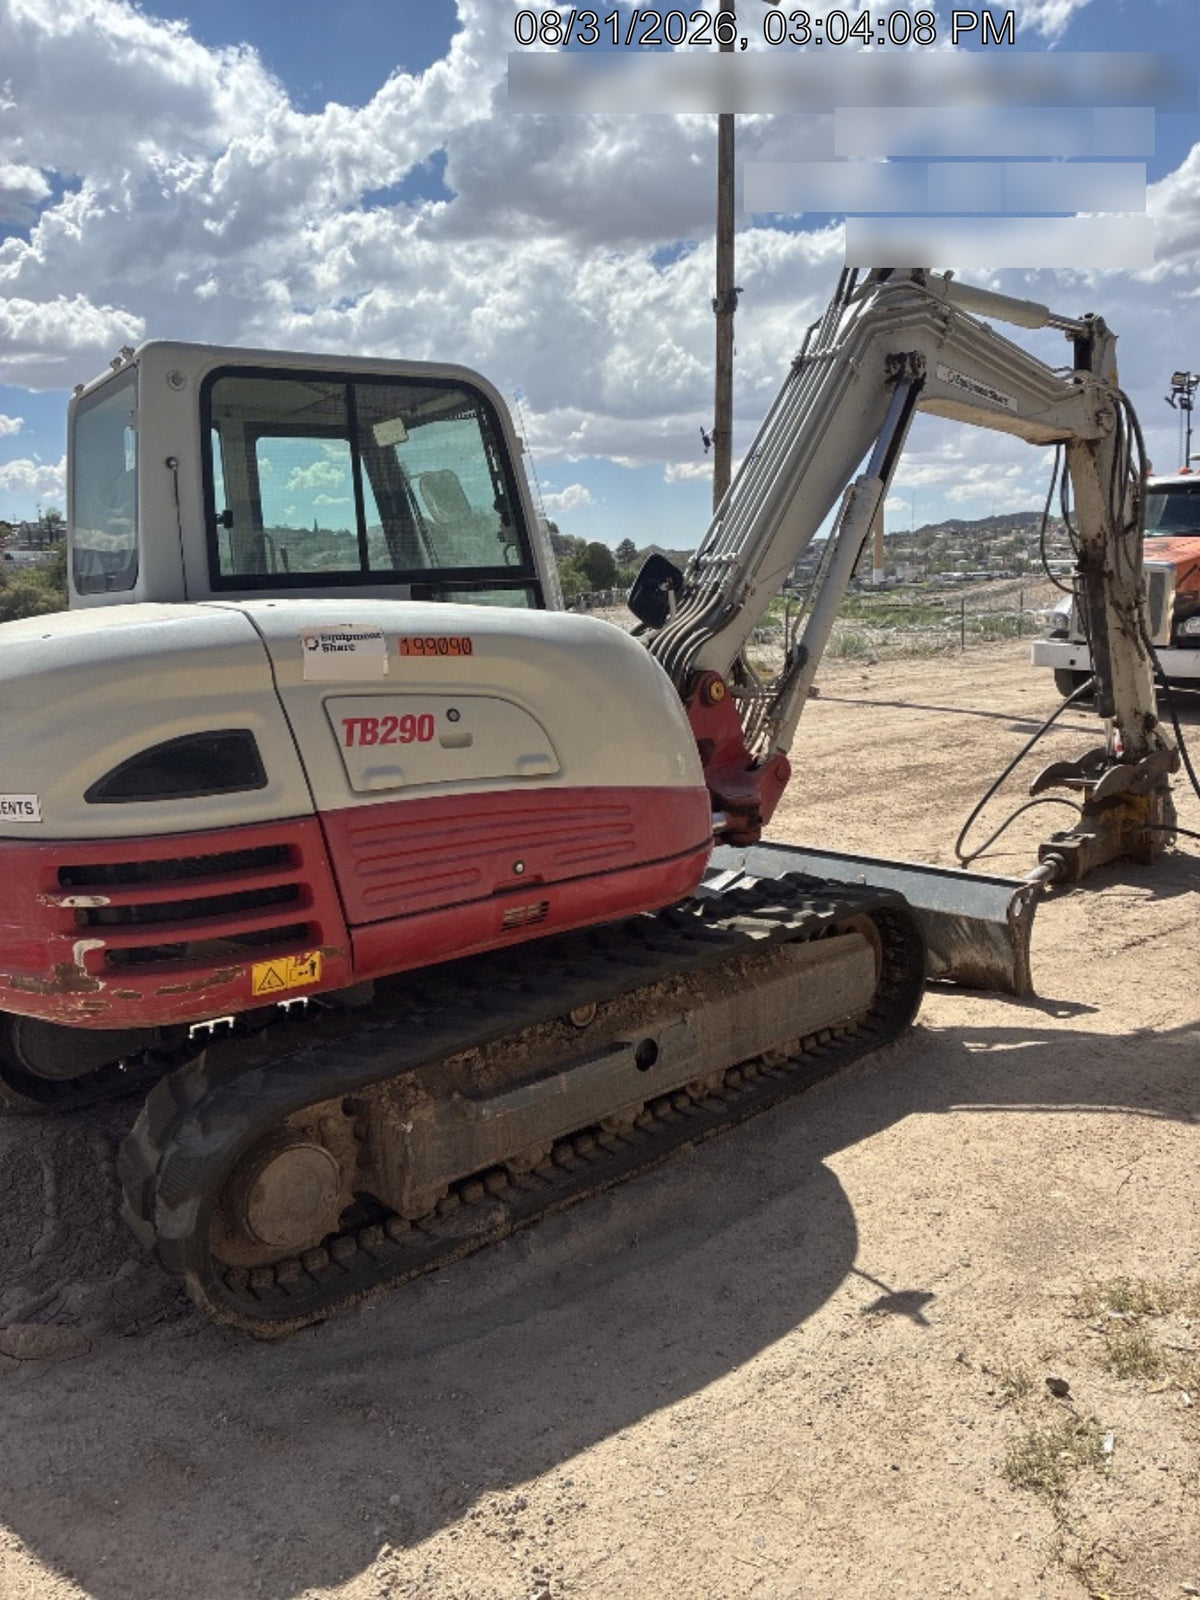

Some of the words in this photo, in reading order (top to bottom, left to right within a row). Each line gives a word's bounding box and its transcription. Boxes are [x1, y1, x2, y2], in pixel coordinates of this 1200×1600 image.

[321, 643, 356, 652] Share
[401, 637, 473, 655] 199090
[342, 714, 434, 747] TB290
[0, 801, 34, 815] ENTS
